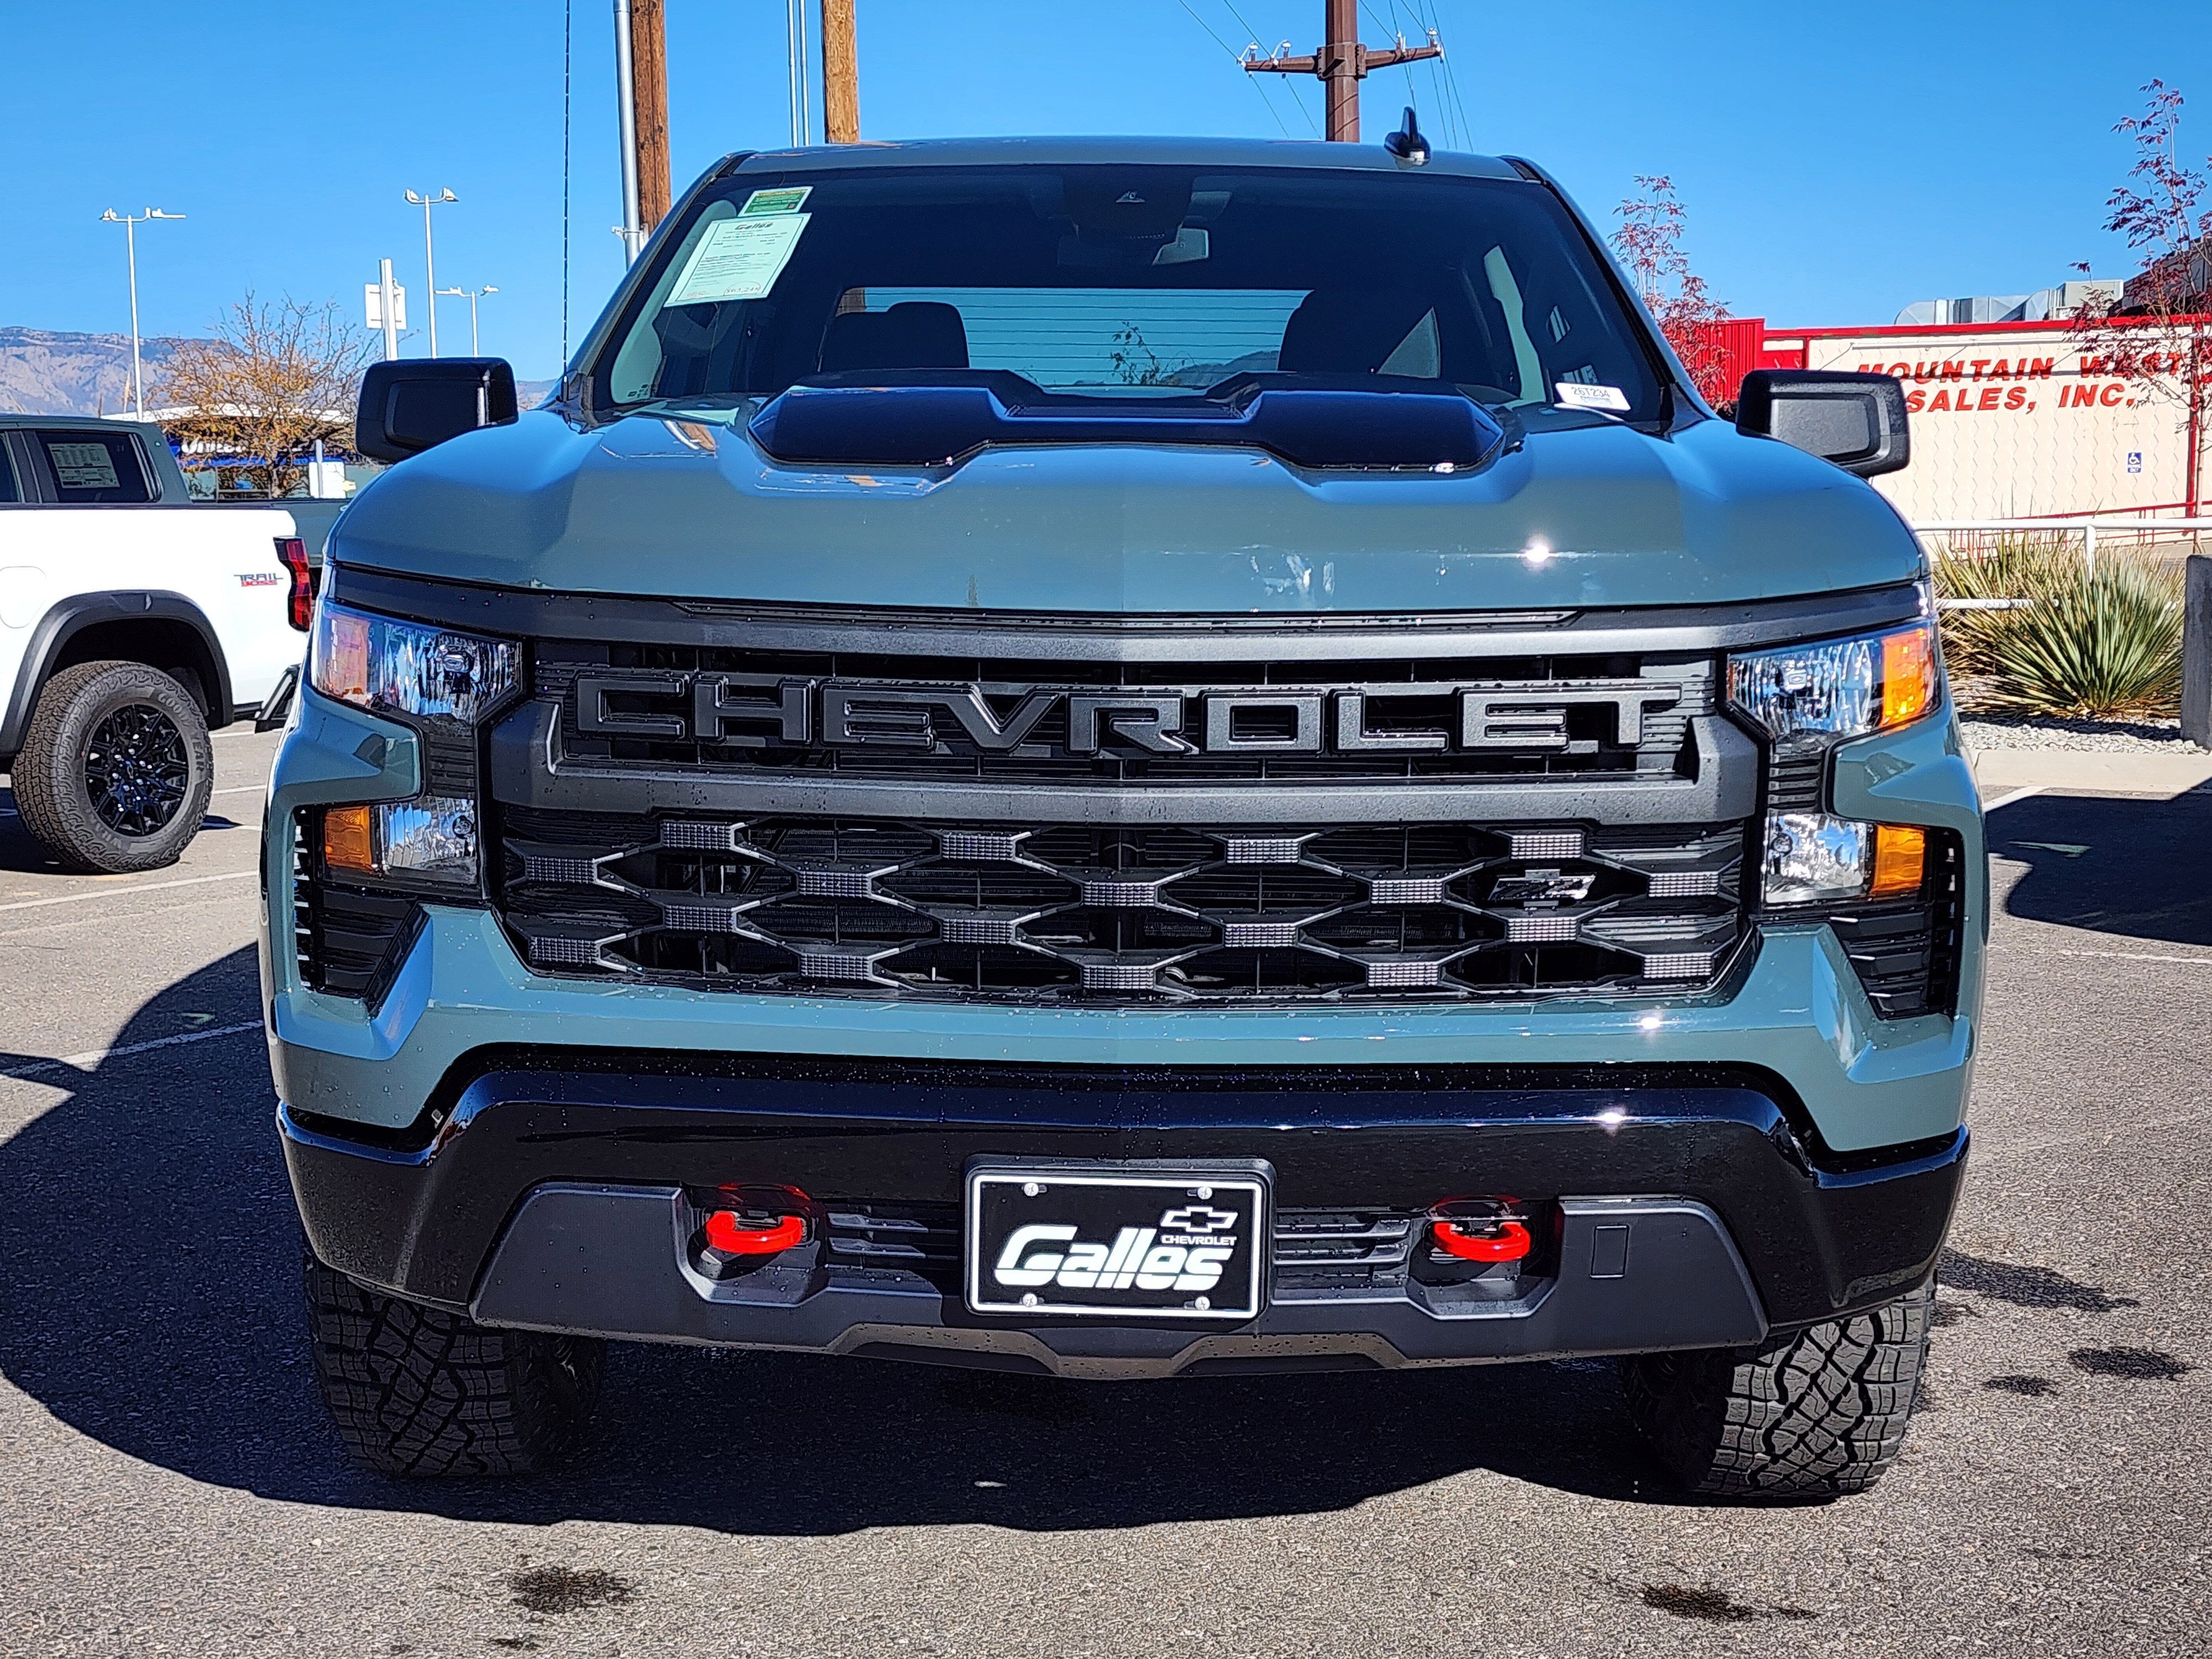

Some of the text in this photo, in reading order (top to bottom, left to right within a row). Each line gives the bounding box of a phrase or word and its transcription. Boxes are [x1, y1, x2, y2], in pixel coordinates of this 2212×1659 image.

[1907, 383, 2135, 414] SALES, INC.
[233, 573, 283, 581] TRAIL
[574, 675, 1682, 755] CHEVROLET
[1161, 1234, 1237, 1246] CHEVROLET
[995, 1224, 1234, 1291] Galles
